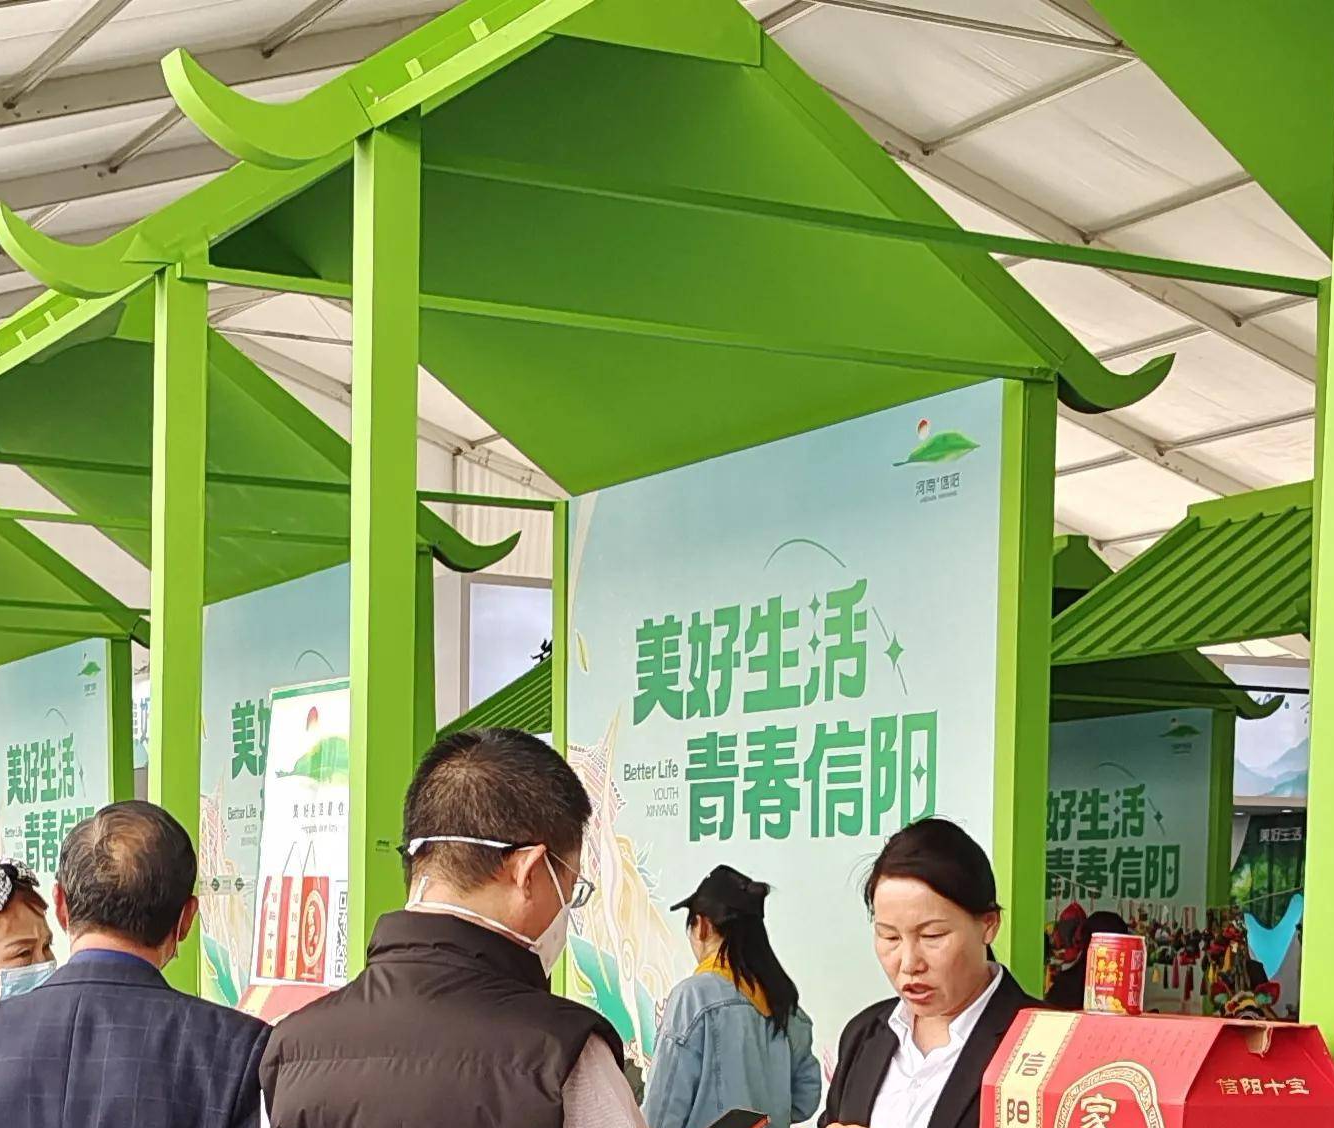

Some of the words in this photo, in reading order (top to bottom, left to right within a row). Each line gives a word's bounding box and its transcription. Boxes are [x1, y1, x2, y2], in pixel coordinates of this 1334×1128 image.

[633, 578, 867, 726] 美好生活
[7, 733, 74, 806] 美好生活
[624, 763, 656, 781] Better
[658, 758, 678, 779] Life
[684, 710, 938, 841] 青春信阳
[645, 803, 679, 817] XINYANG
[653, 788, 679, 801] YOUTH
